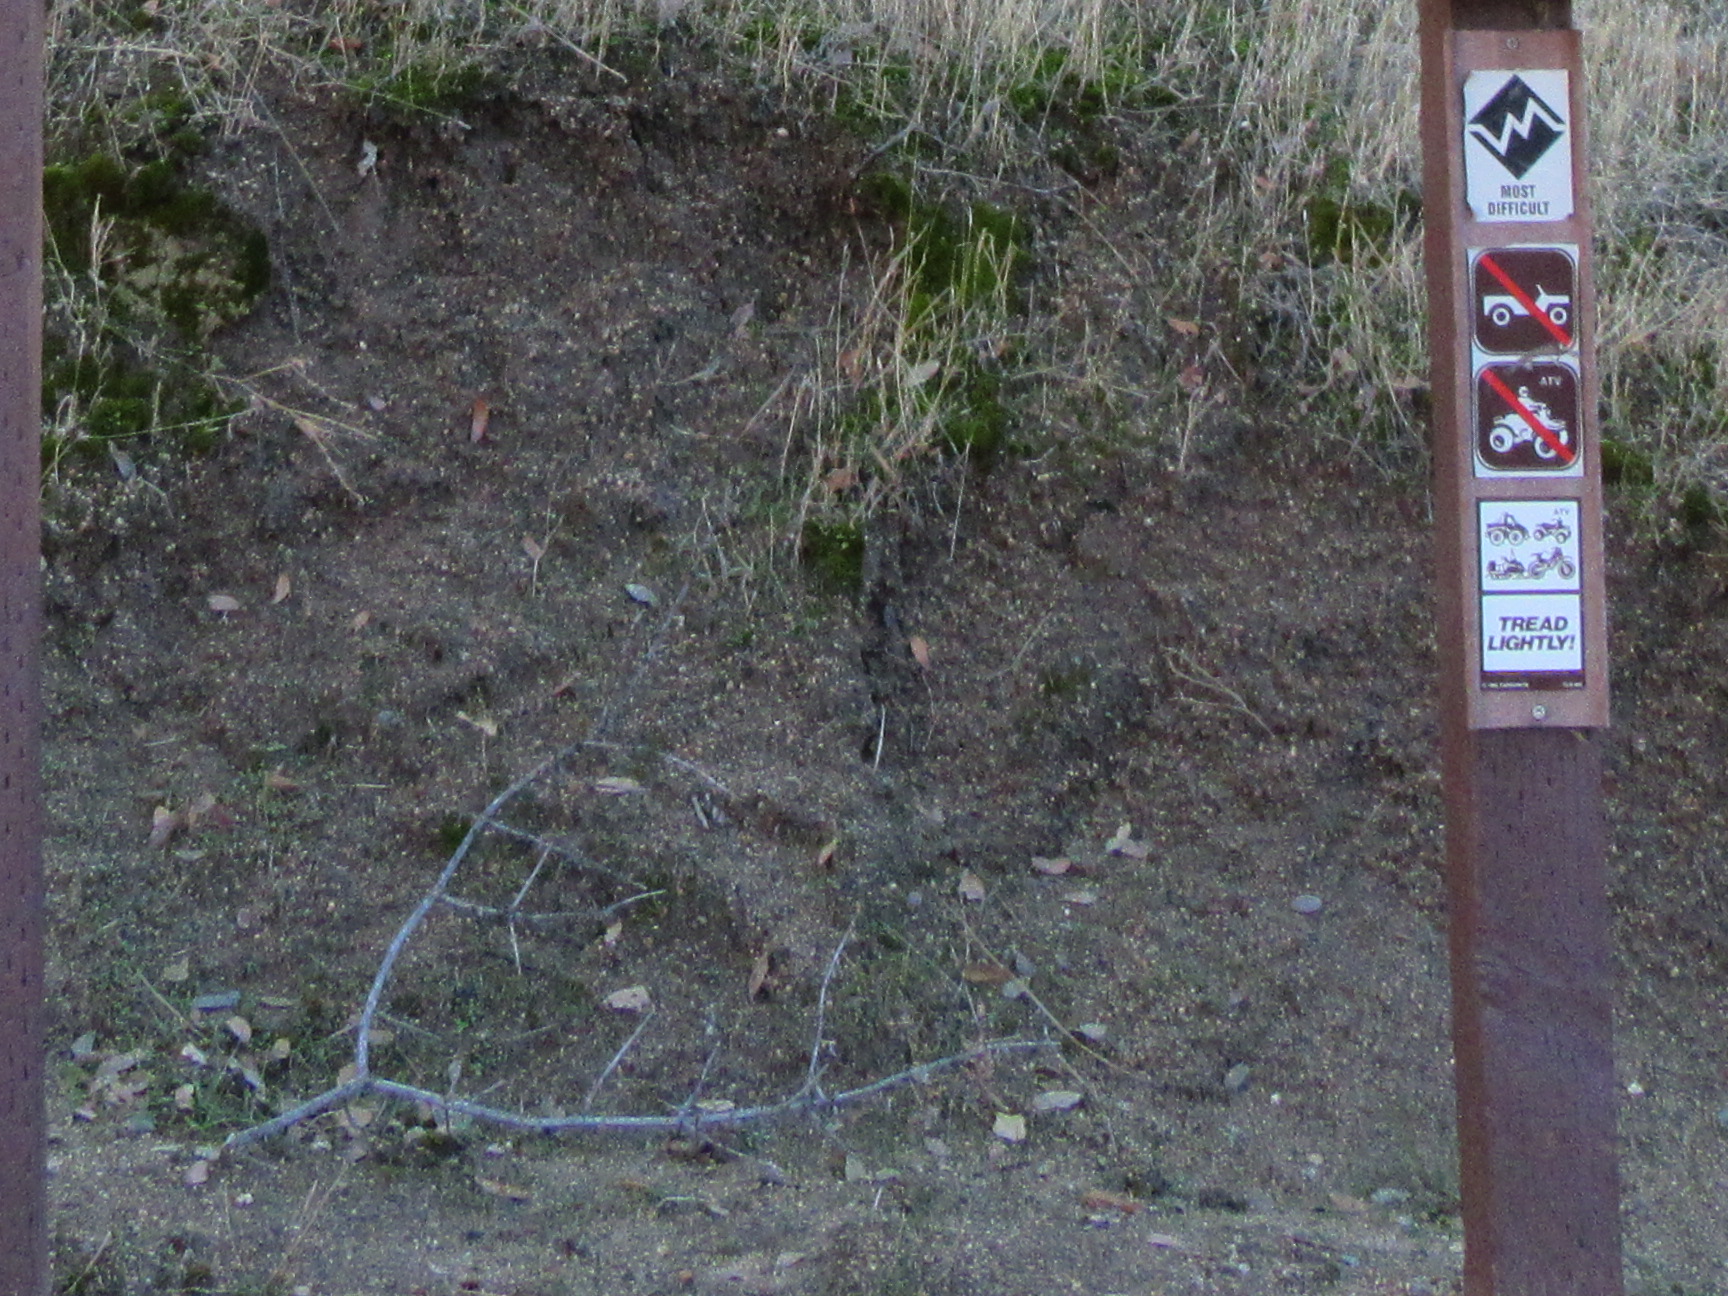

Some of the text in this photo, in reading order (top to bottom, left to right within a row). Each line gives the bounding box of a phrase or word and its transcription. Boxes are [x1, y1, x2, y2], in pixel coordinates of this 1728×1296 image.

[1500, 184, 1537, 199] MOST
[1487, 201, 1551, 216] DIFFICULT
[1538, 375, 1562, 386] ATV
[1498, 615, 1569, 633] TREAD
[1487, 634, 1576, 652] LIGHTLY!
